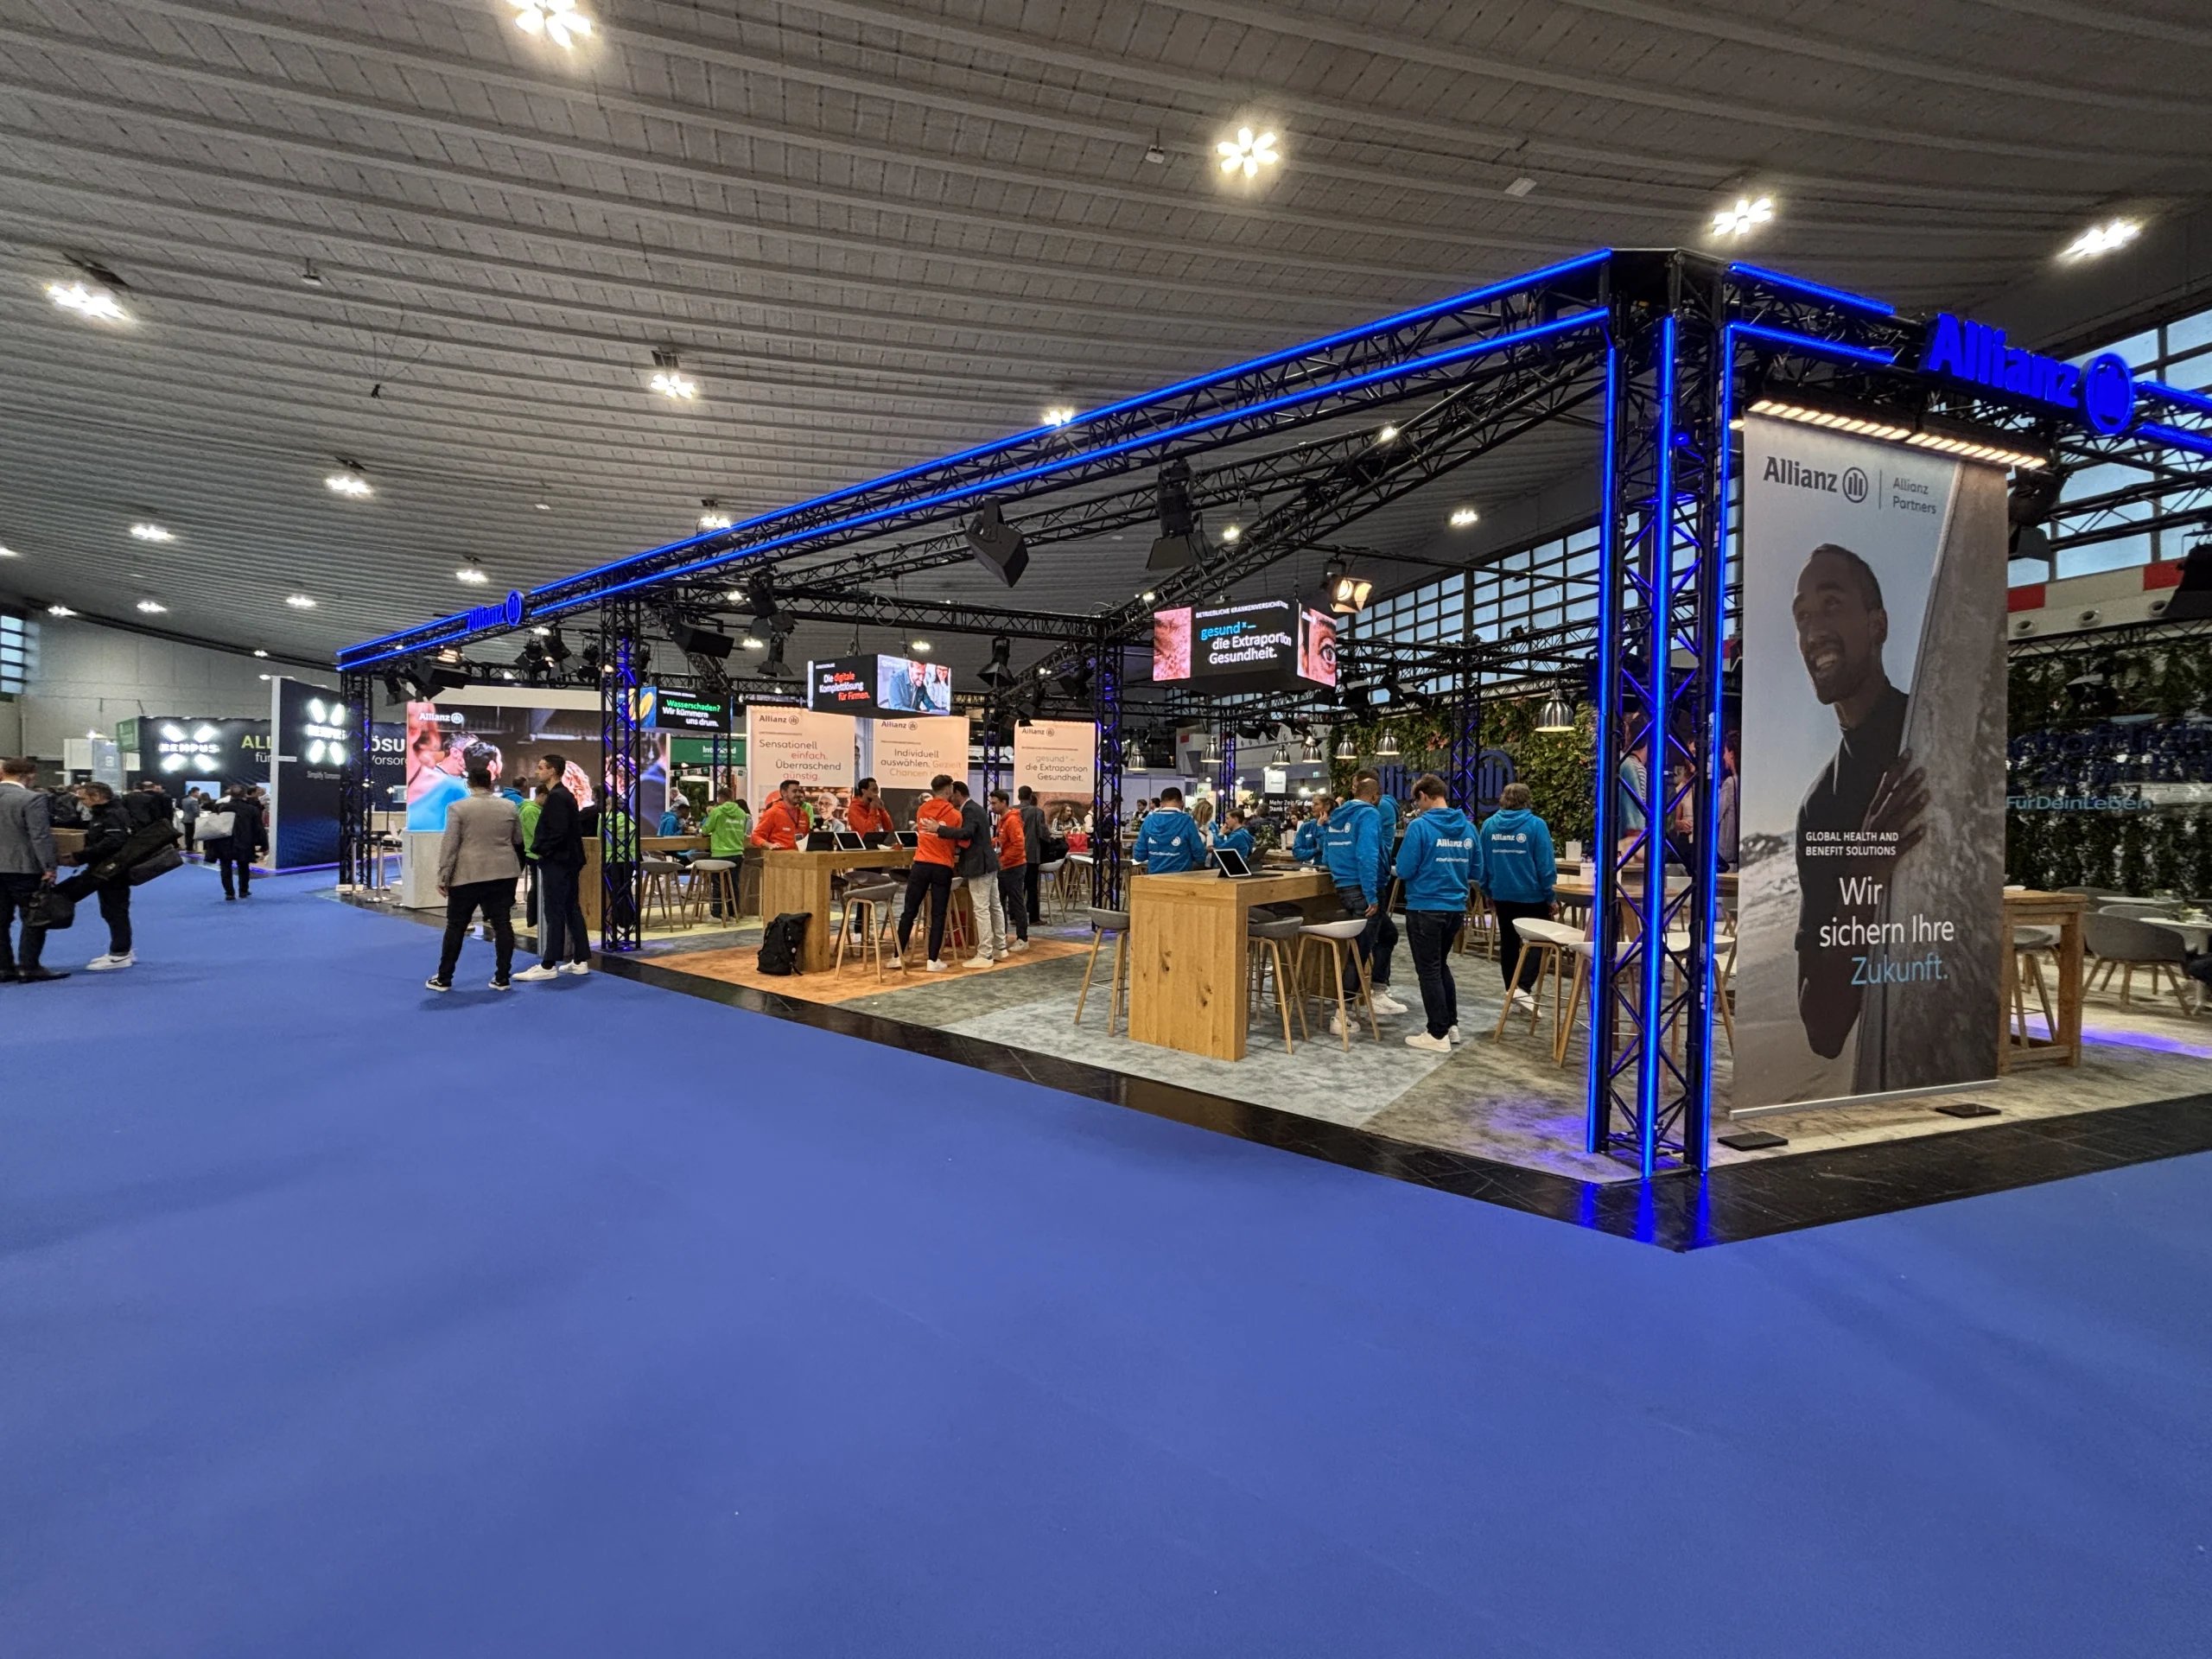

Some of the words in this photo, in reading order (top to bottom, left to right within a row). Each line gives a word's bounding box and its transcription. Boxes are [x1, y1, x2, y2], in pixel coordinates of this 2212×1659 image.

[1928, 312, 2082, 409] Allianz
[1763, 455, 1838, 493] Allianz
[1892, 477, 1929, 495] Allianz
[1892, 495, 1937, 514] Partners
[1212, 637, 1230, 651] die
[1232, 632, 1292, 650] Extraportion
[1209, 646, 1278, 664] Gesundheit.
[823, 673, 835, 683] Die
[834, 671, 855, 683] digitale
[819, 681, 864, 694] Komplettlösung
[837, 692, 848, 701] für
[848, 690, 871, 701] Firmen.
[666, 699, 721, 712] Wasserschaden?
[419, 713, 450, 721] Allianz
[662, 706, 676, 715] Wir
[676, 708, 709, 718] kümmern
[759, 715, 787, 723] Allianz
[759, 739, 818, 750] Sensationell
[791, 751, 828, 760] einfach.
[894, 748, 939, 759] Individuell
[775, 759, 842, 771] Überraschend
[880, 759, 931, 768] auswählen.
[1039, 764, 1088, 772] Extraportion
[1037, 772, 1084, 781] Gesundheit.
[1805, 831, 1841, 842] GLOBAL
[1843, 831, 1878, 842] HEALTH
[1879, 831, 1899, 842] AND
[1436, 838, 1463, 848] Allianz
[1805, 846, 1844, 855] BENEFIT
[1846, 846, 1897, 855] SOLUTIONS
[1839, 875, 1883, 905] Wir
[1819, 916, 1904, 947] sichern
[1912, 913, 1955, 943] Ihre
[1851, 951, 1948, 985] Zukunft.
